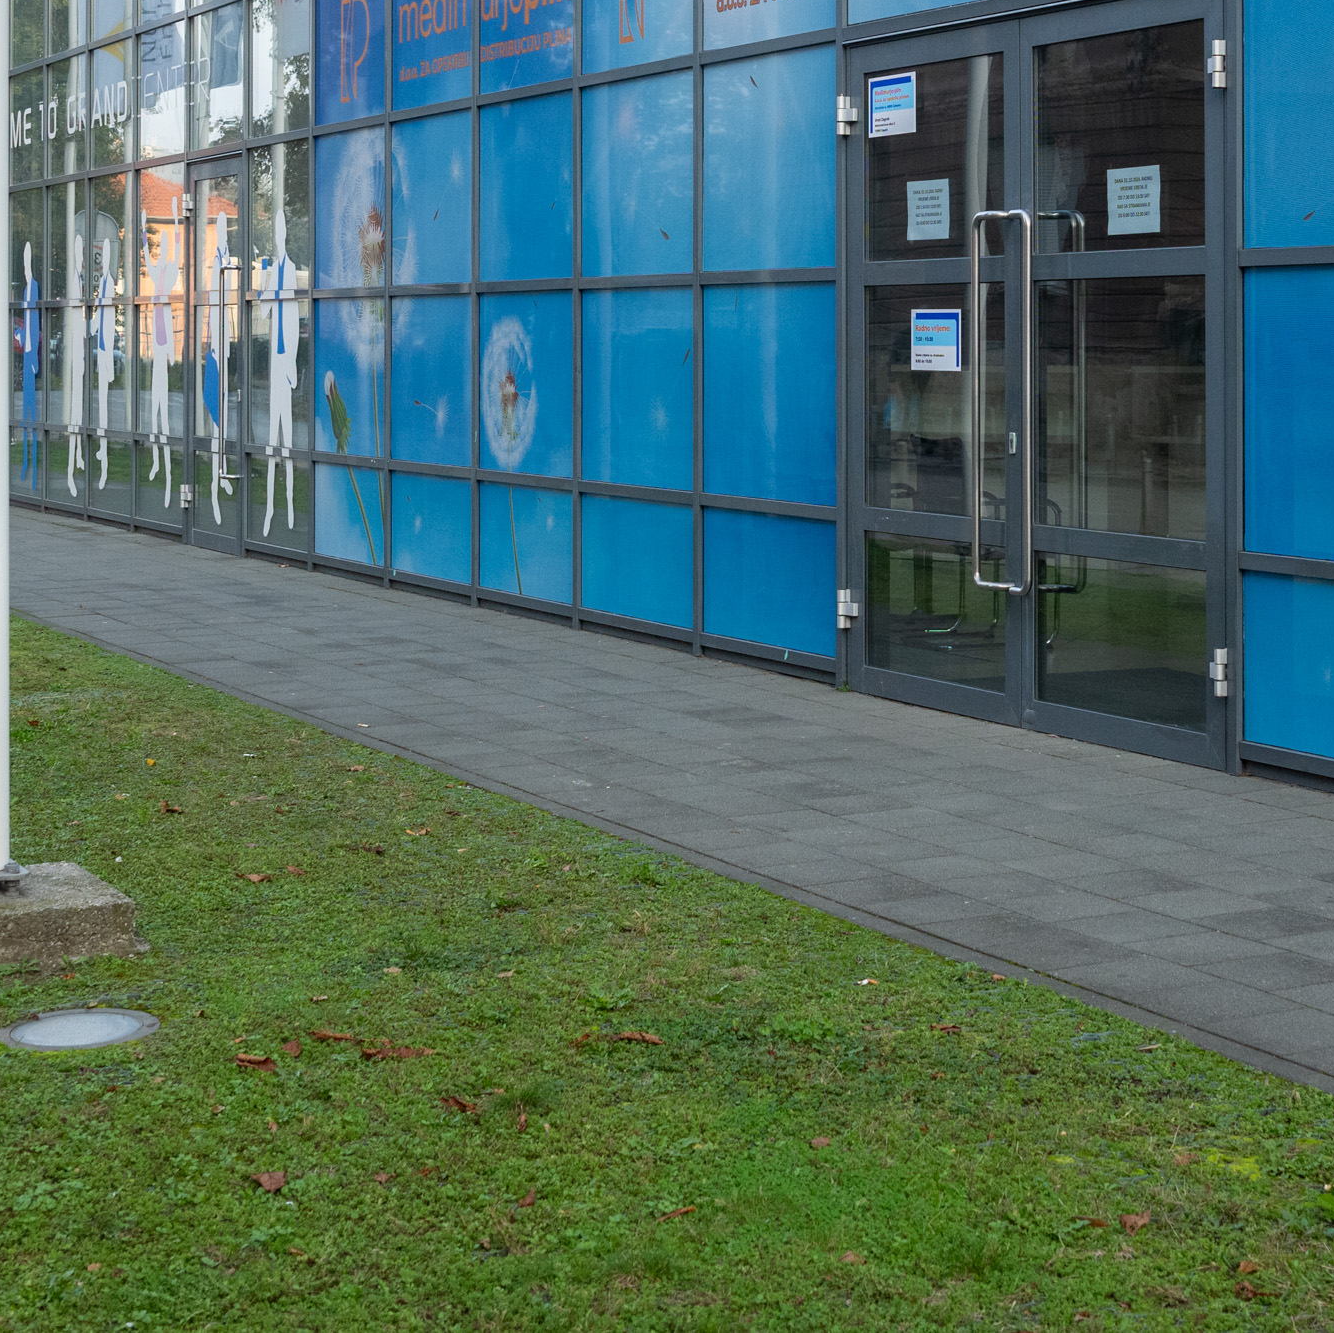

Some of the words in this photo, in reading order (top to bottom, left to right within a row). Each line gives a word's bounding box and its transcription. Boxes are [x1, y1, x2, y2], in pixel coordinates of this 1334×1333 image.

[420, 61, 430, 77] ZA
[432, 50, 471, 75] OPSKRBU
[480, 33, 541, 63] DISTRIBUCIJU
[543, 27, 573, 50] PLINA
[39, 101, 57, 141] TO
[67, 81, 128, 135] GRAND
[915, 324, 930, 332] Radno
